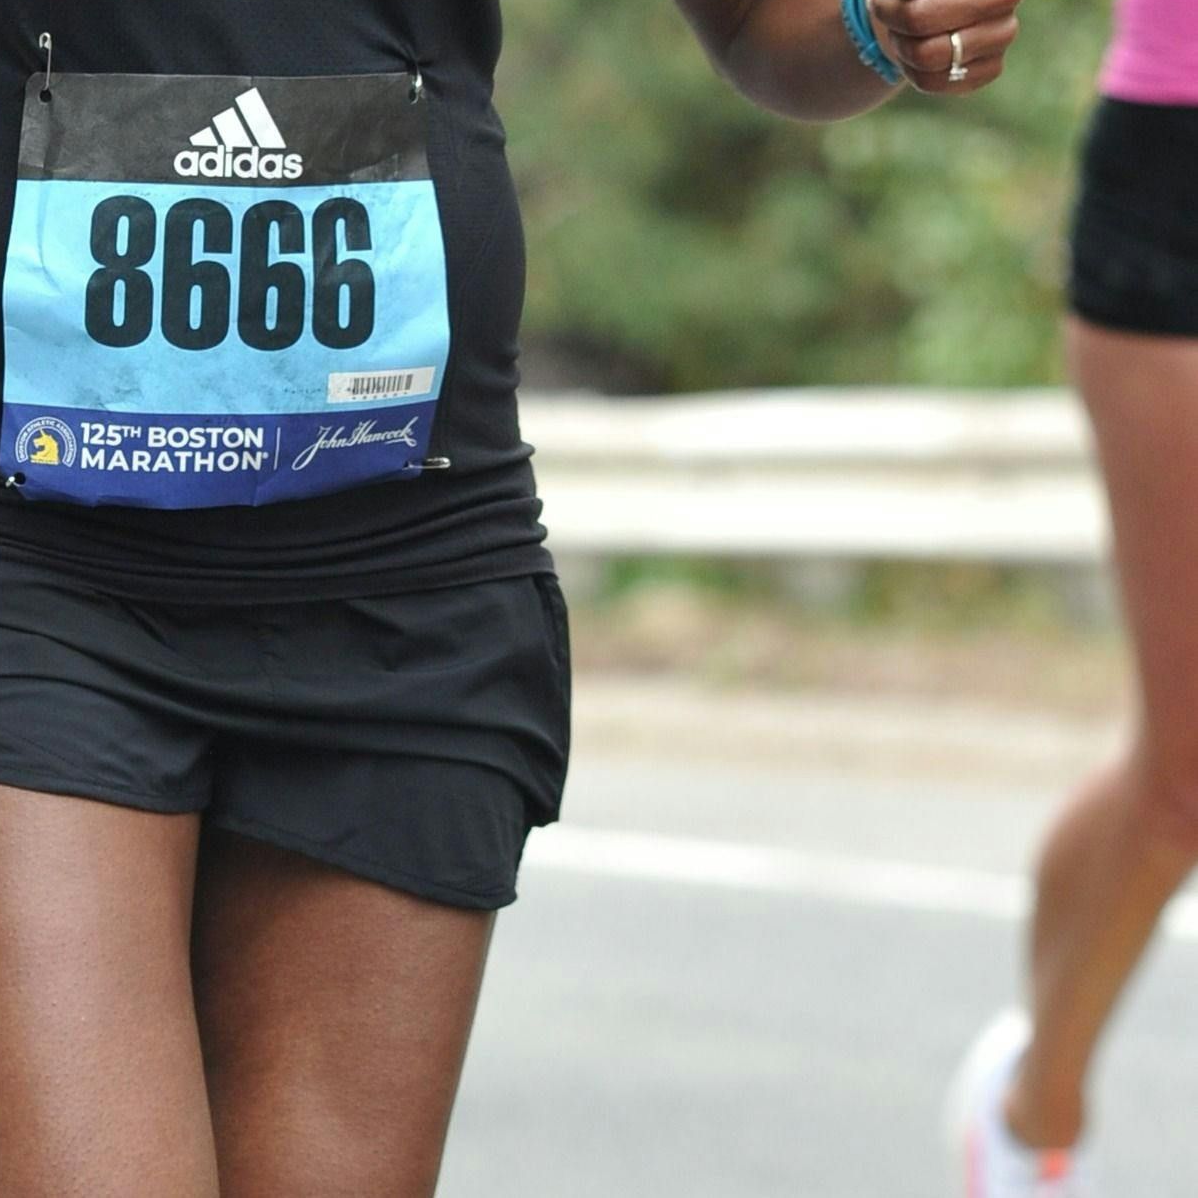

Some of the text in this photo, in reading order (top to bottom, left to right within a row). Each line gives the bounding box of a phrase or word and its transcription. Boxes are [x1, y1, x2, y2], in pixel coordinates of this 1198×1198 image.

[173, 146, 303, 179] adidas
[84, 195, 375, 351] 8666
[81, 422, 264, 448] 125TH BOSTON
[291, 416, 419, 471] John Hancock
